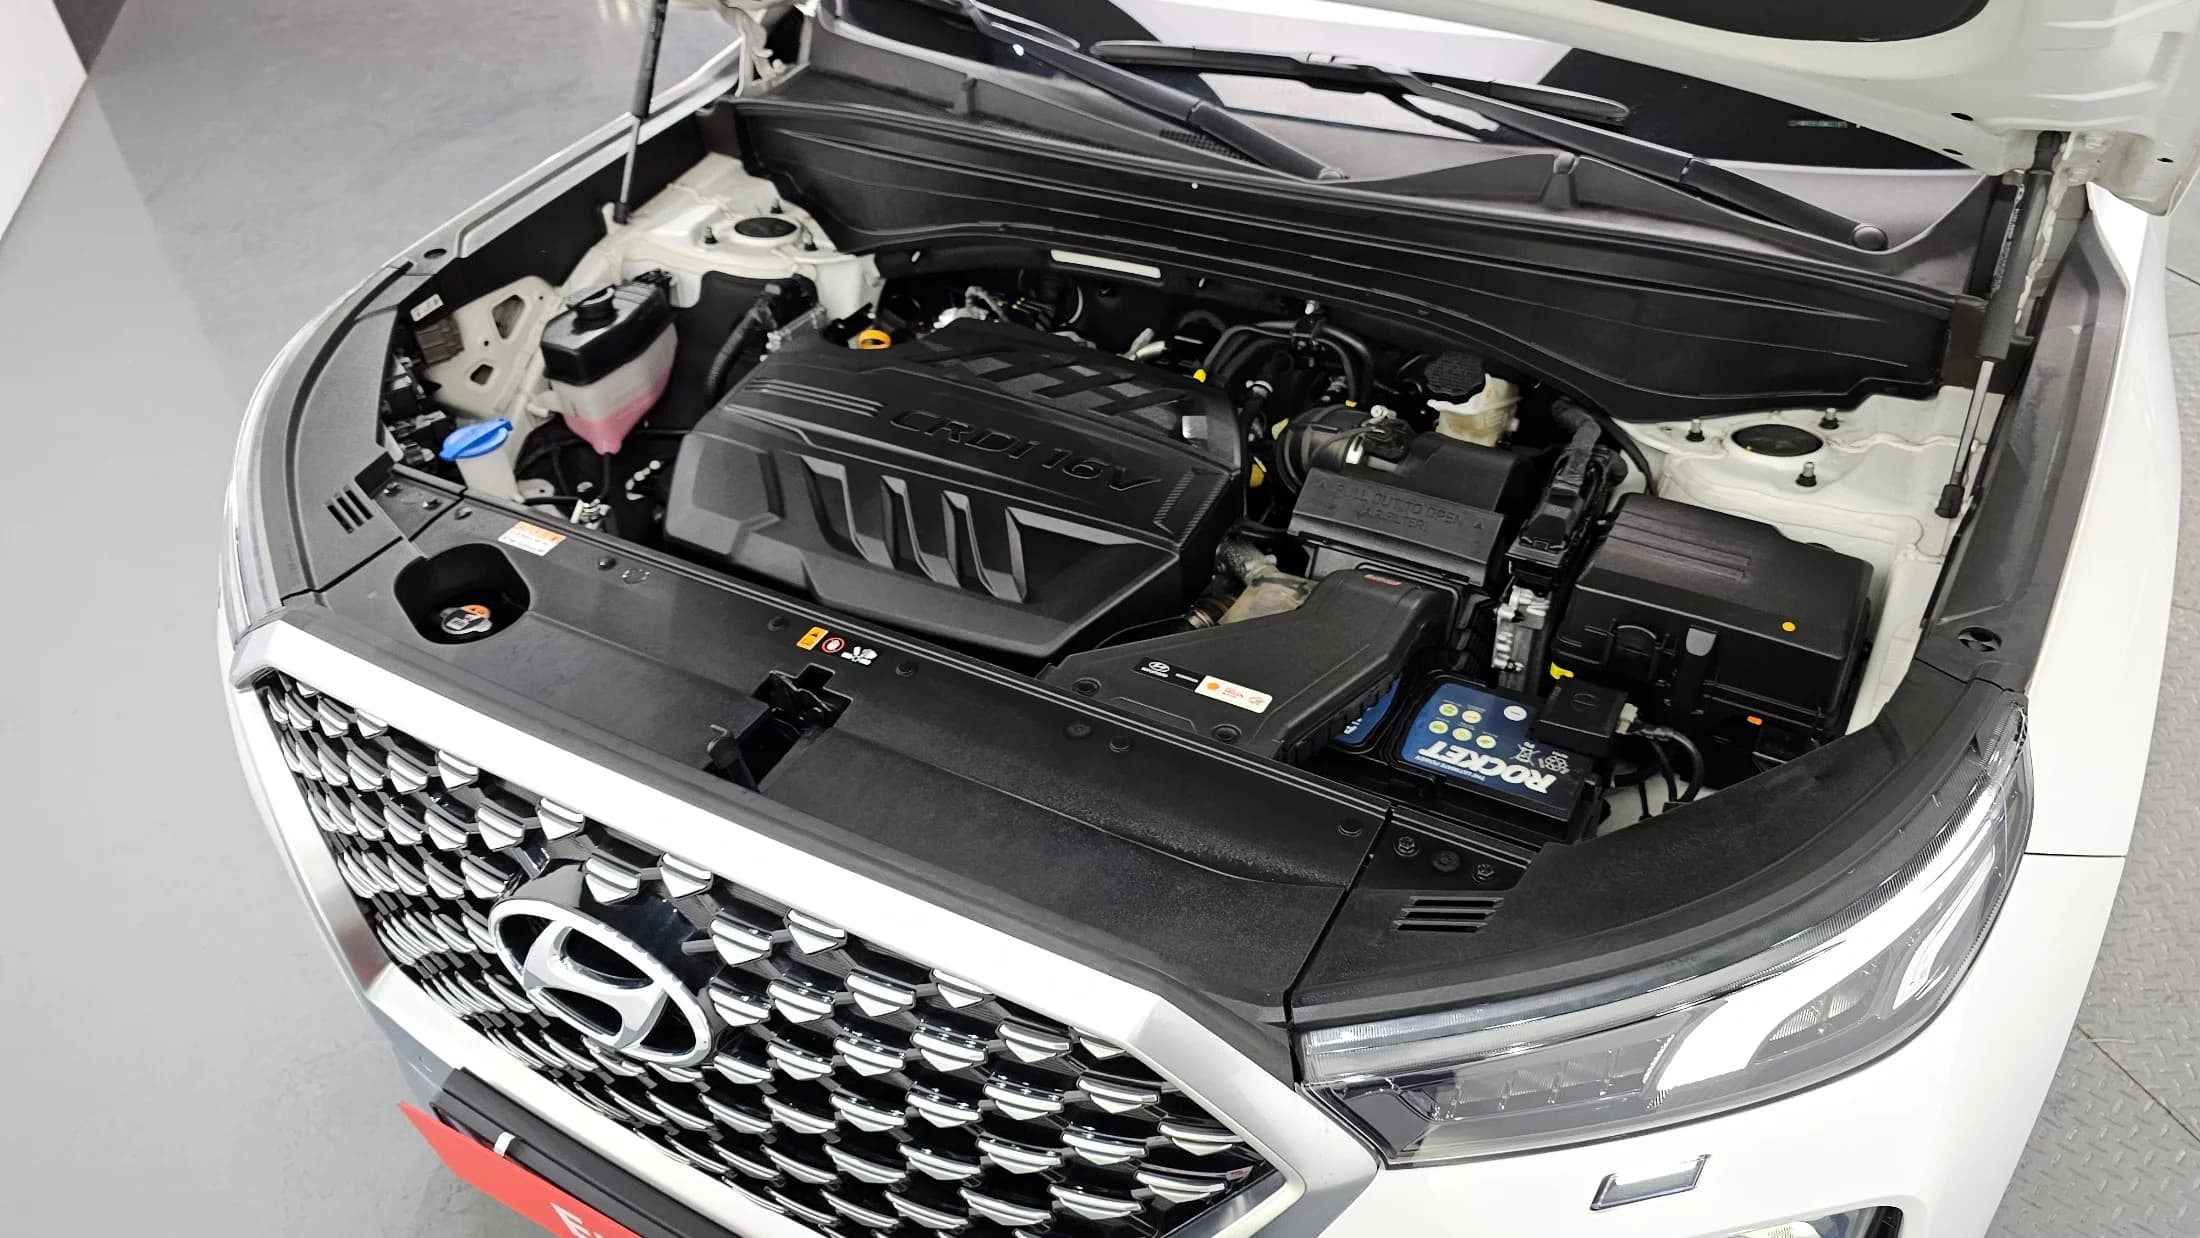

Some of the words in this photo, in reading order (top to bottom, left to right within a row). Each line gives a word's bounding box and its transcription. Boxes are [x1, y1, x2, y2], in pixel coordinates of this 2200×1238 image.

[1041, 447, 1163, 492] 16V
[1335, 483, 1368, 503] PULL
[1372, 491, 1404, 511] OUT
[1403, 499, 1424, 515] TO
[1426, 506, 1464, 527] OPEN
[1417, 740, 1557, 793] ROCKET
